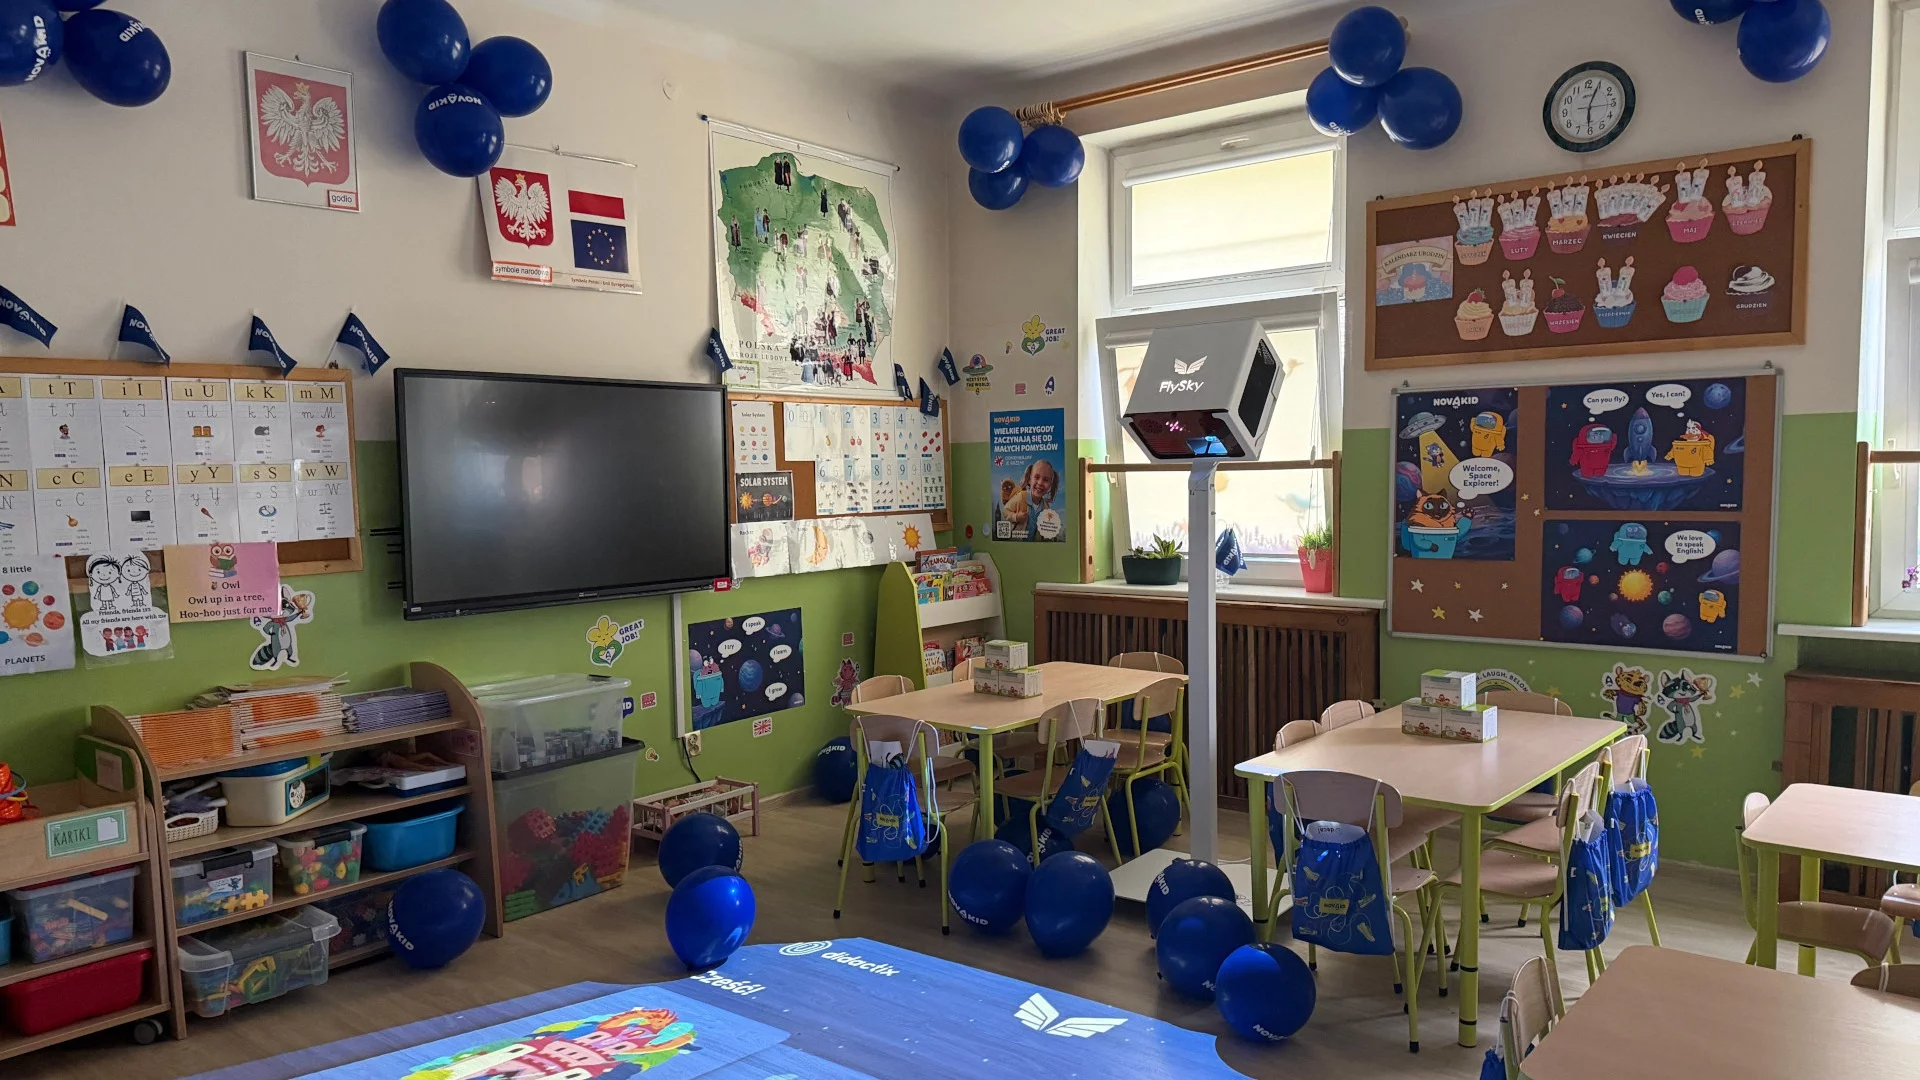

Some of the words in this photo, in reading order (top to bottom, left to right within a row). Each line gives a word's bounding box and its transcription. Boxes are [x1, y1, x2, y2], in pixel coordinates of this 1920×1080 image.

[1585, 79, 1592, 89] 12
[1573, 86, 1580, 94] 11
[1607, 87, 1612, 96] 2
[428, 93, 482, 111] NOVAKID
[1564, 96, 1572, 105] 10
[1610, 98, 1616, 107] 3
[1562, 108, 1568, 117] 9
[1567, 119, 1572, 128] 8
[1599, 121, 1605, 129] 5
[1576, 126, 1580, 135] 7
[1587, 127, 1593, 135] 6
[1552, 238, 1583, 246] MARZEC
[1384, 251, 1417, 266] KALENDARZ
[1418, 250, 1445, 260] URODZIN
[739, 340, 779, 351] POLSKA
[709, 338, 726, 368] OVAKID
[942, 353, 955, 381] OVAKID
[49, 384, 54, 395] t
[64, 382, 76, 395] T
[123, 383, 127, 395] i
[137, 383, 143, 395] I
[184, 387, 193, 397] u
[202, 384, 215, 397] U
[246, 385, 255, 398] k
[262, 385, 275, 398] K
[300, 389, 312, 398] m
[320, 386, 335, 399] M
[1159, 380, 1204, 394] FlySky
[1433, 396, 1479, 409] NOVAKID
[789, 410, 794, 422] 0
[819, 412, 823, 422] 1
[845, 412, 851, 423] 2
[872, 413, 878, 424] 3
[898, 413, 903, 424] 4
[1020, 425, 1054, 434] PRZYGODY
[994, 436, 1031, 444] ZACZYNAJĄ
[1032, 435, 1041, 443] SIĘ
[1021, 442, 1058, 451] POMYSŁÓW
[253, 470, 260, 479] s
[269, 466, 277, 479] S
[305, 467, 317, 477] w
[324, 464, 339, 476] W
[820, 466, 825, 477] 6
[848, 466, 853, 475] 7
[874, 465, 880, 476] 8
[900, 464, 905, 475] 9
[923, 463, 931, 473] 10
[1462, 465, 1500, 473] Welcome,
[52, 475, 61, 485] c
[71, 471, 84, 485] C
[125, 474, 133, 482] e
[143, 469, 154, 482] E
[190, 470, 198, 482] y
[208, 466, 220, 479] Y
[1469, 472, 1492, 481] Space
[740, 478, 761, 487] SOLAR
[763, 477, 788, 486] SYSTEM
[1463, 479, 1499, 488] Explorer!
[10, 565, 32, 573] little
[221, 581, 240, 589] Owl
[188, 596, 207, 605] Owl
[209, 595, 222, 605] up
[225, 594, 234, 602] in
[243, 593, 265, 603] tree,
[179, 609, 221, 619] Hoo-hoo
[223, 607, 241, 617] just
[243, 606, 256, 614] for
[619, 621, 643, 636] GREAT
[749, 620, 762, 628] speak
[621, 632, 638, 644] JOB!
[5, 654, 46, 664] PLANETS
[1482, 671, 1508, 680] LAUGH,
[1509, 675, 1529, 692] BELON
[53, 828, 91, 847] KARTKI
[821, 950, 900, 977] didactix
[691, 970, 766, 996] Cześć!
